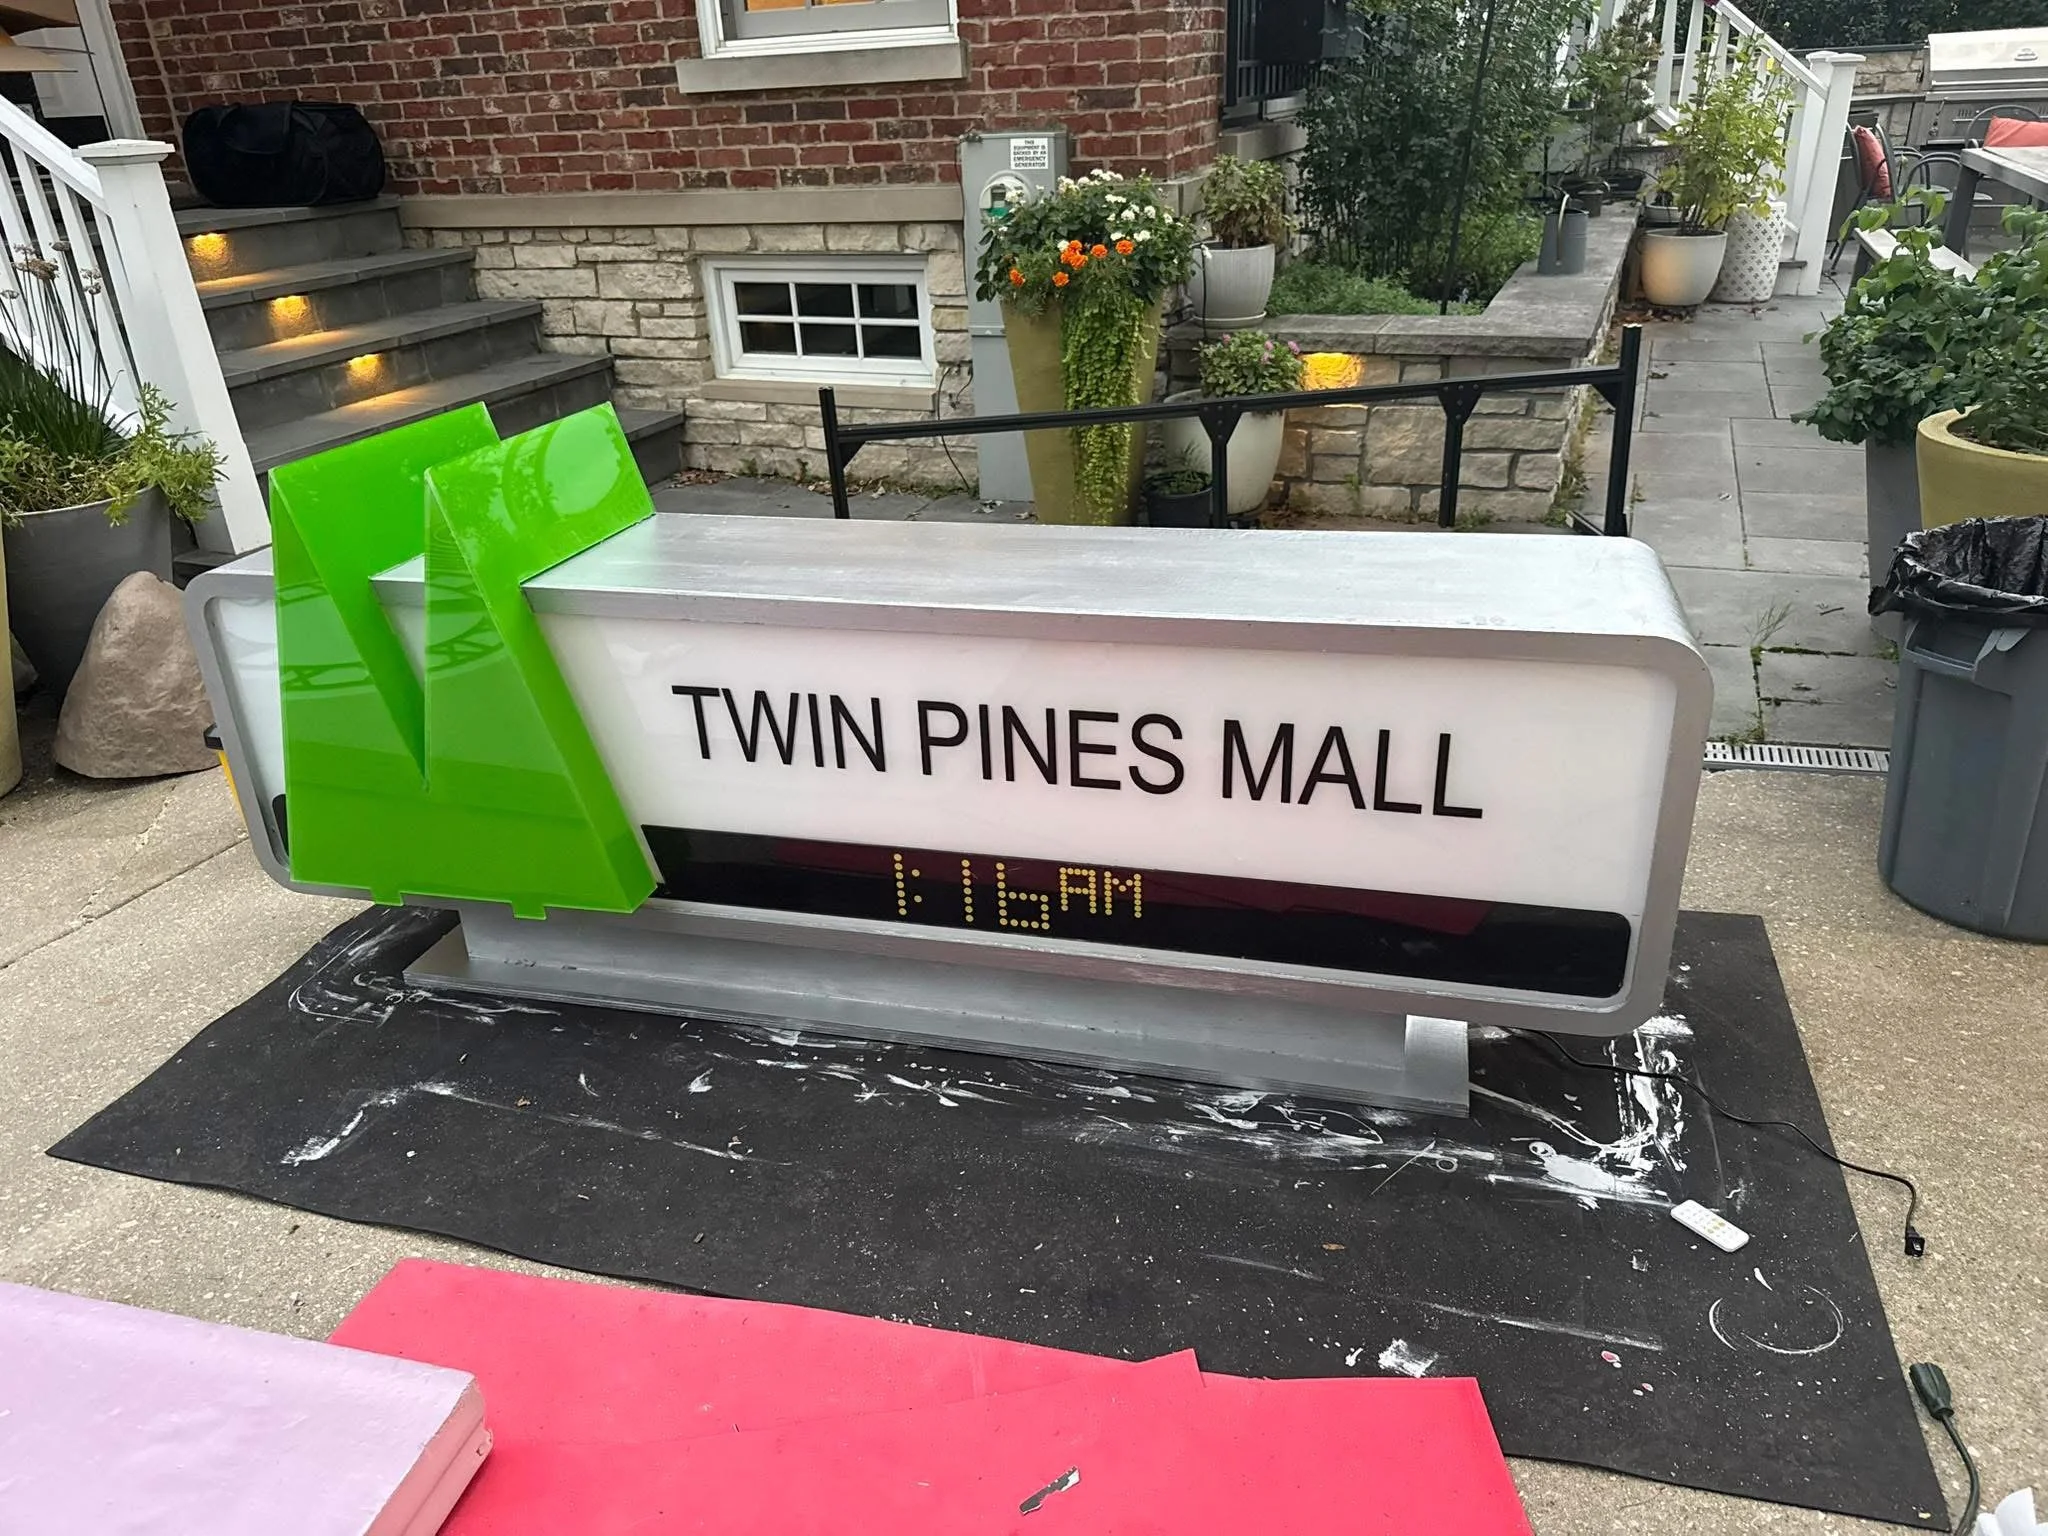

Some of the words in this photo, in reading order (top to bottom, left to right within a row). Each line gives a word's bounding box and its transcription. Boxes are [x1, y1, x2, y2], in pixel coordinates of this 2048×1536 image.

[672, 686, 885, 772] TWIN
[918, 701, 1184, 794] PINES
[1223, 720, 1482, 818] MALL
